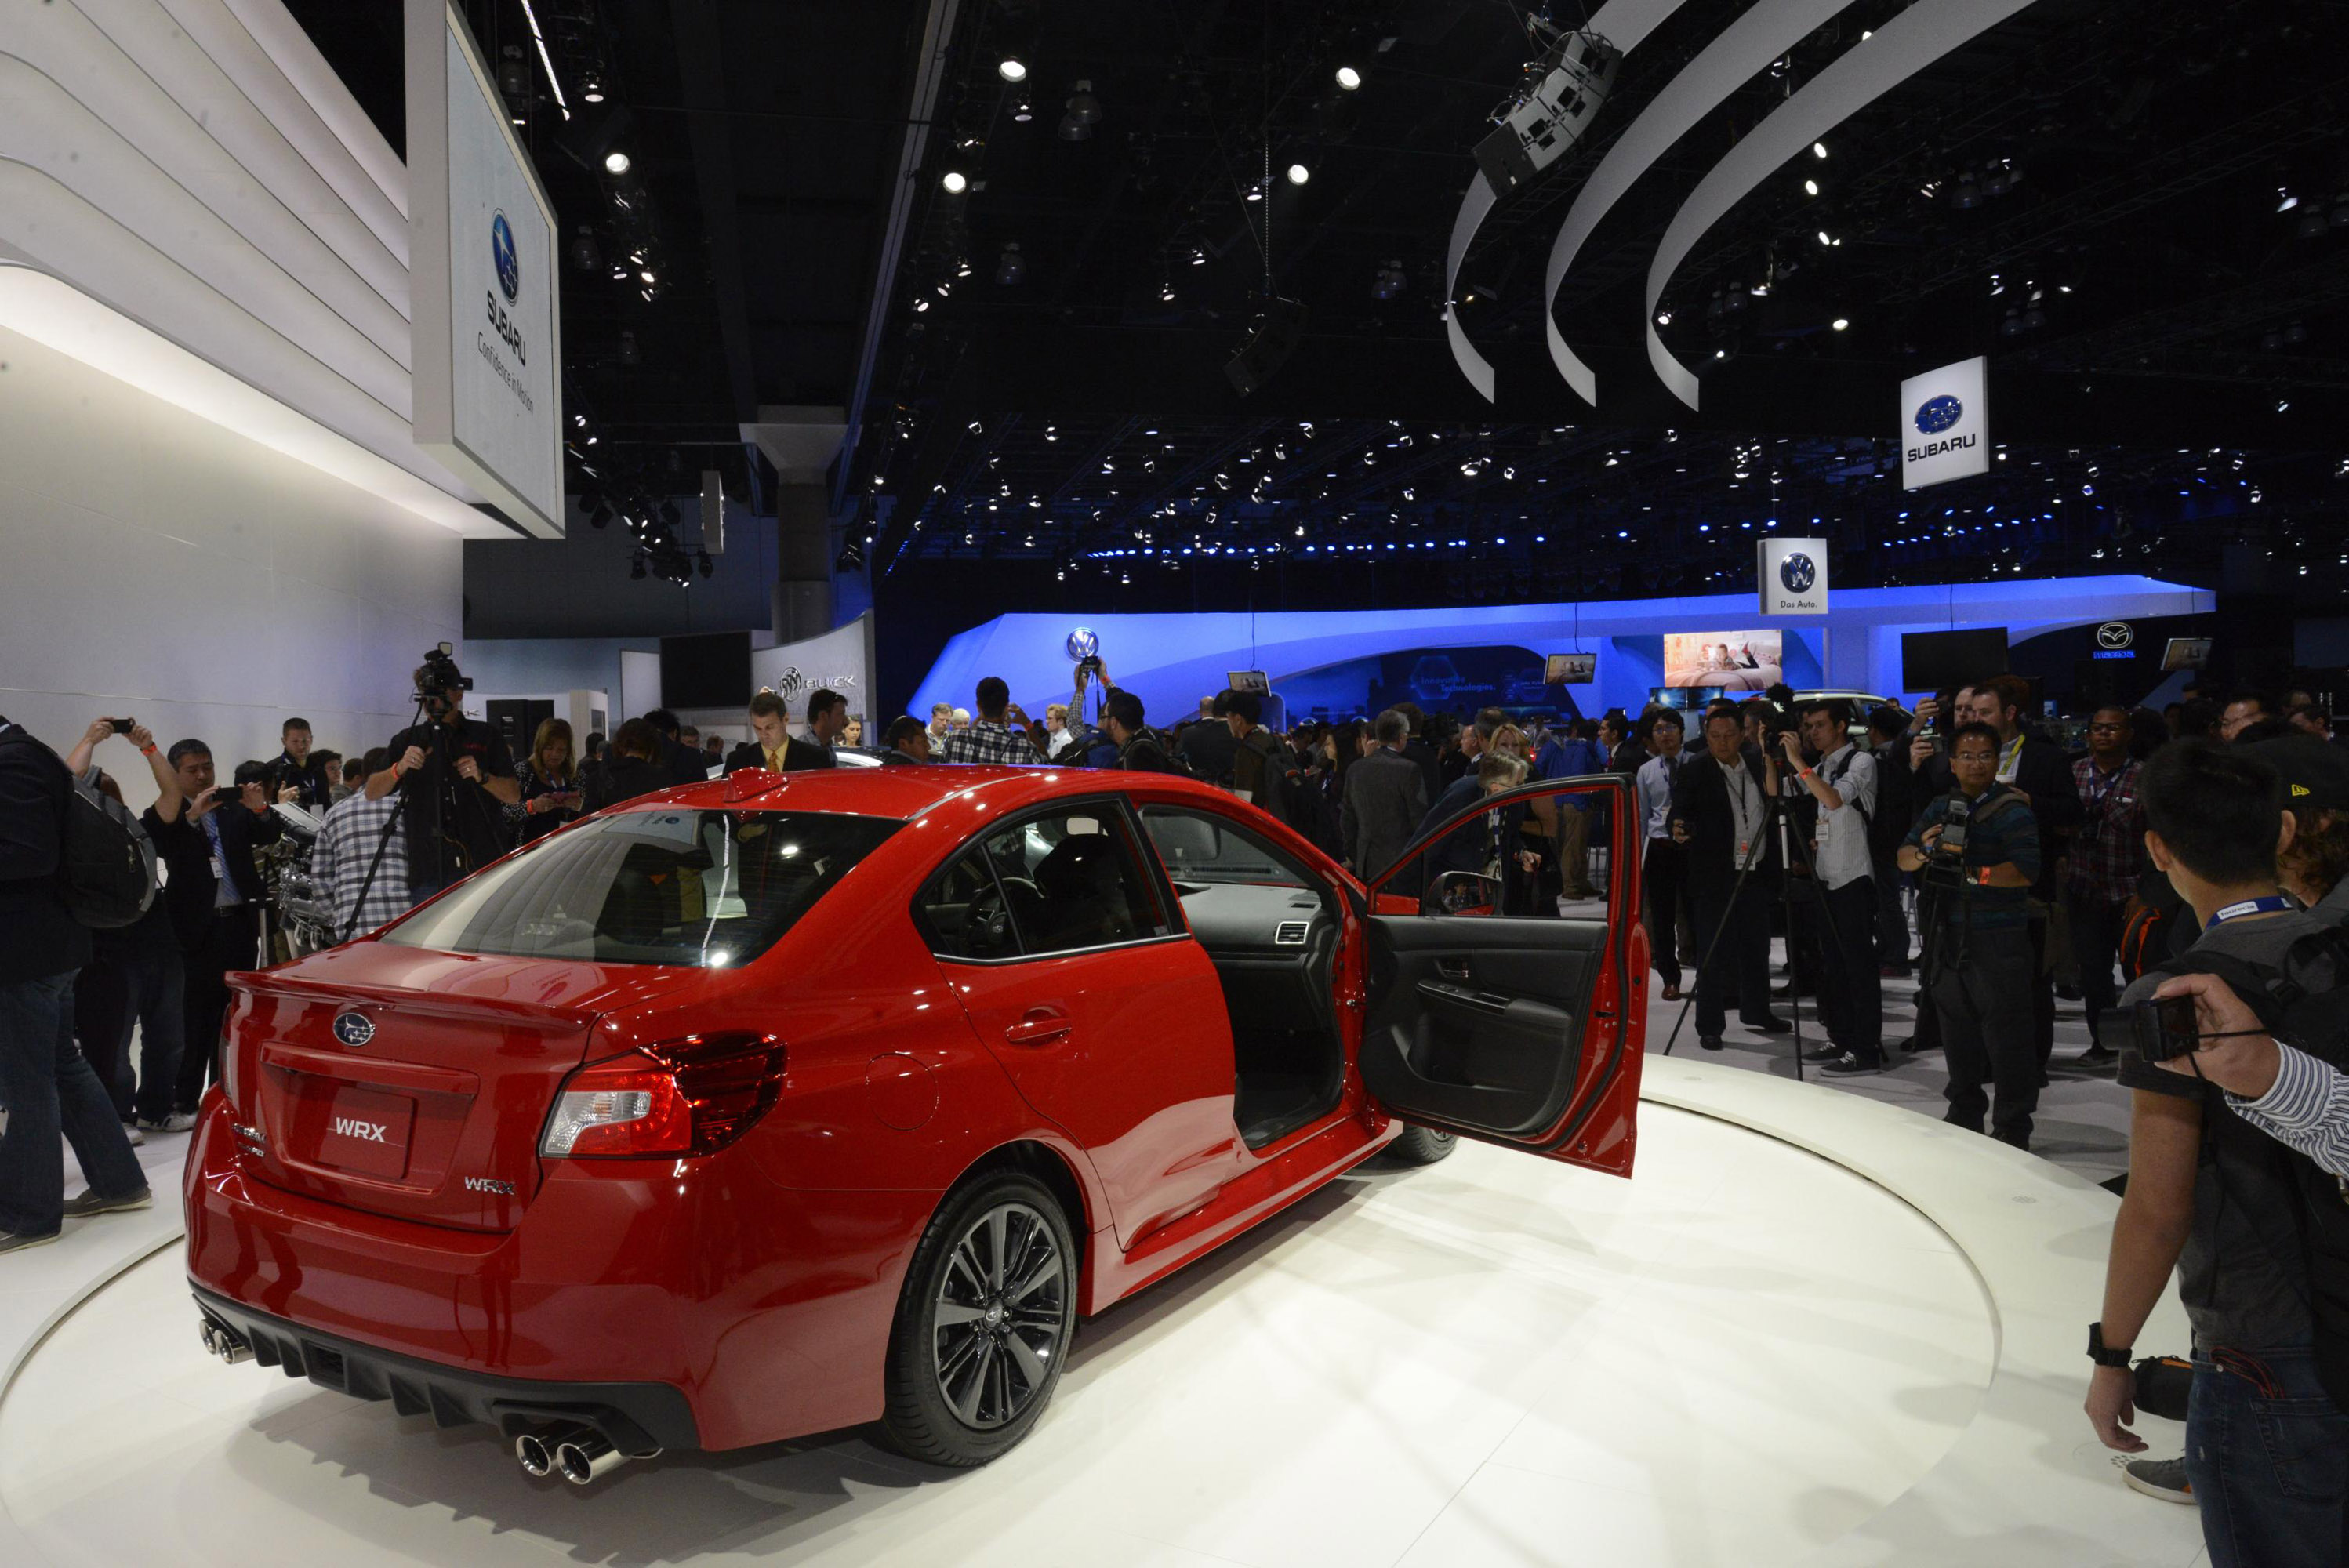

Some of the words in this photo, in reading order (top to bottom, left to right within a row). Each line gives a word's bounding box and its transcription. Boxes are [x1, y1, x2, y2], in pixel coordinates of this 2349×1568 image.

[487, 289, 526, 367] SUBARU
[477, 331, 511, 387] Confidence
[517, 379, 534, 415] Motion
[1907, 433, 1976, 463] SUBARU
[1781, 600, 1795, 608] Das
[1797, 600, 1818, 608] Auto.
[804, 676, 855, 690] BUICK
[336, 1116, 387, 1142] WRX
[464, 1176, 514, 1196] WRX
